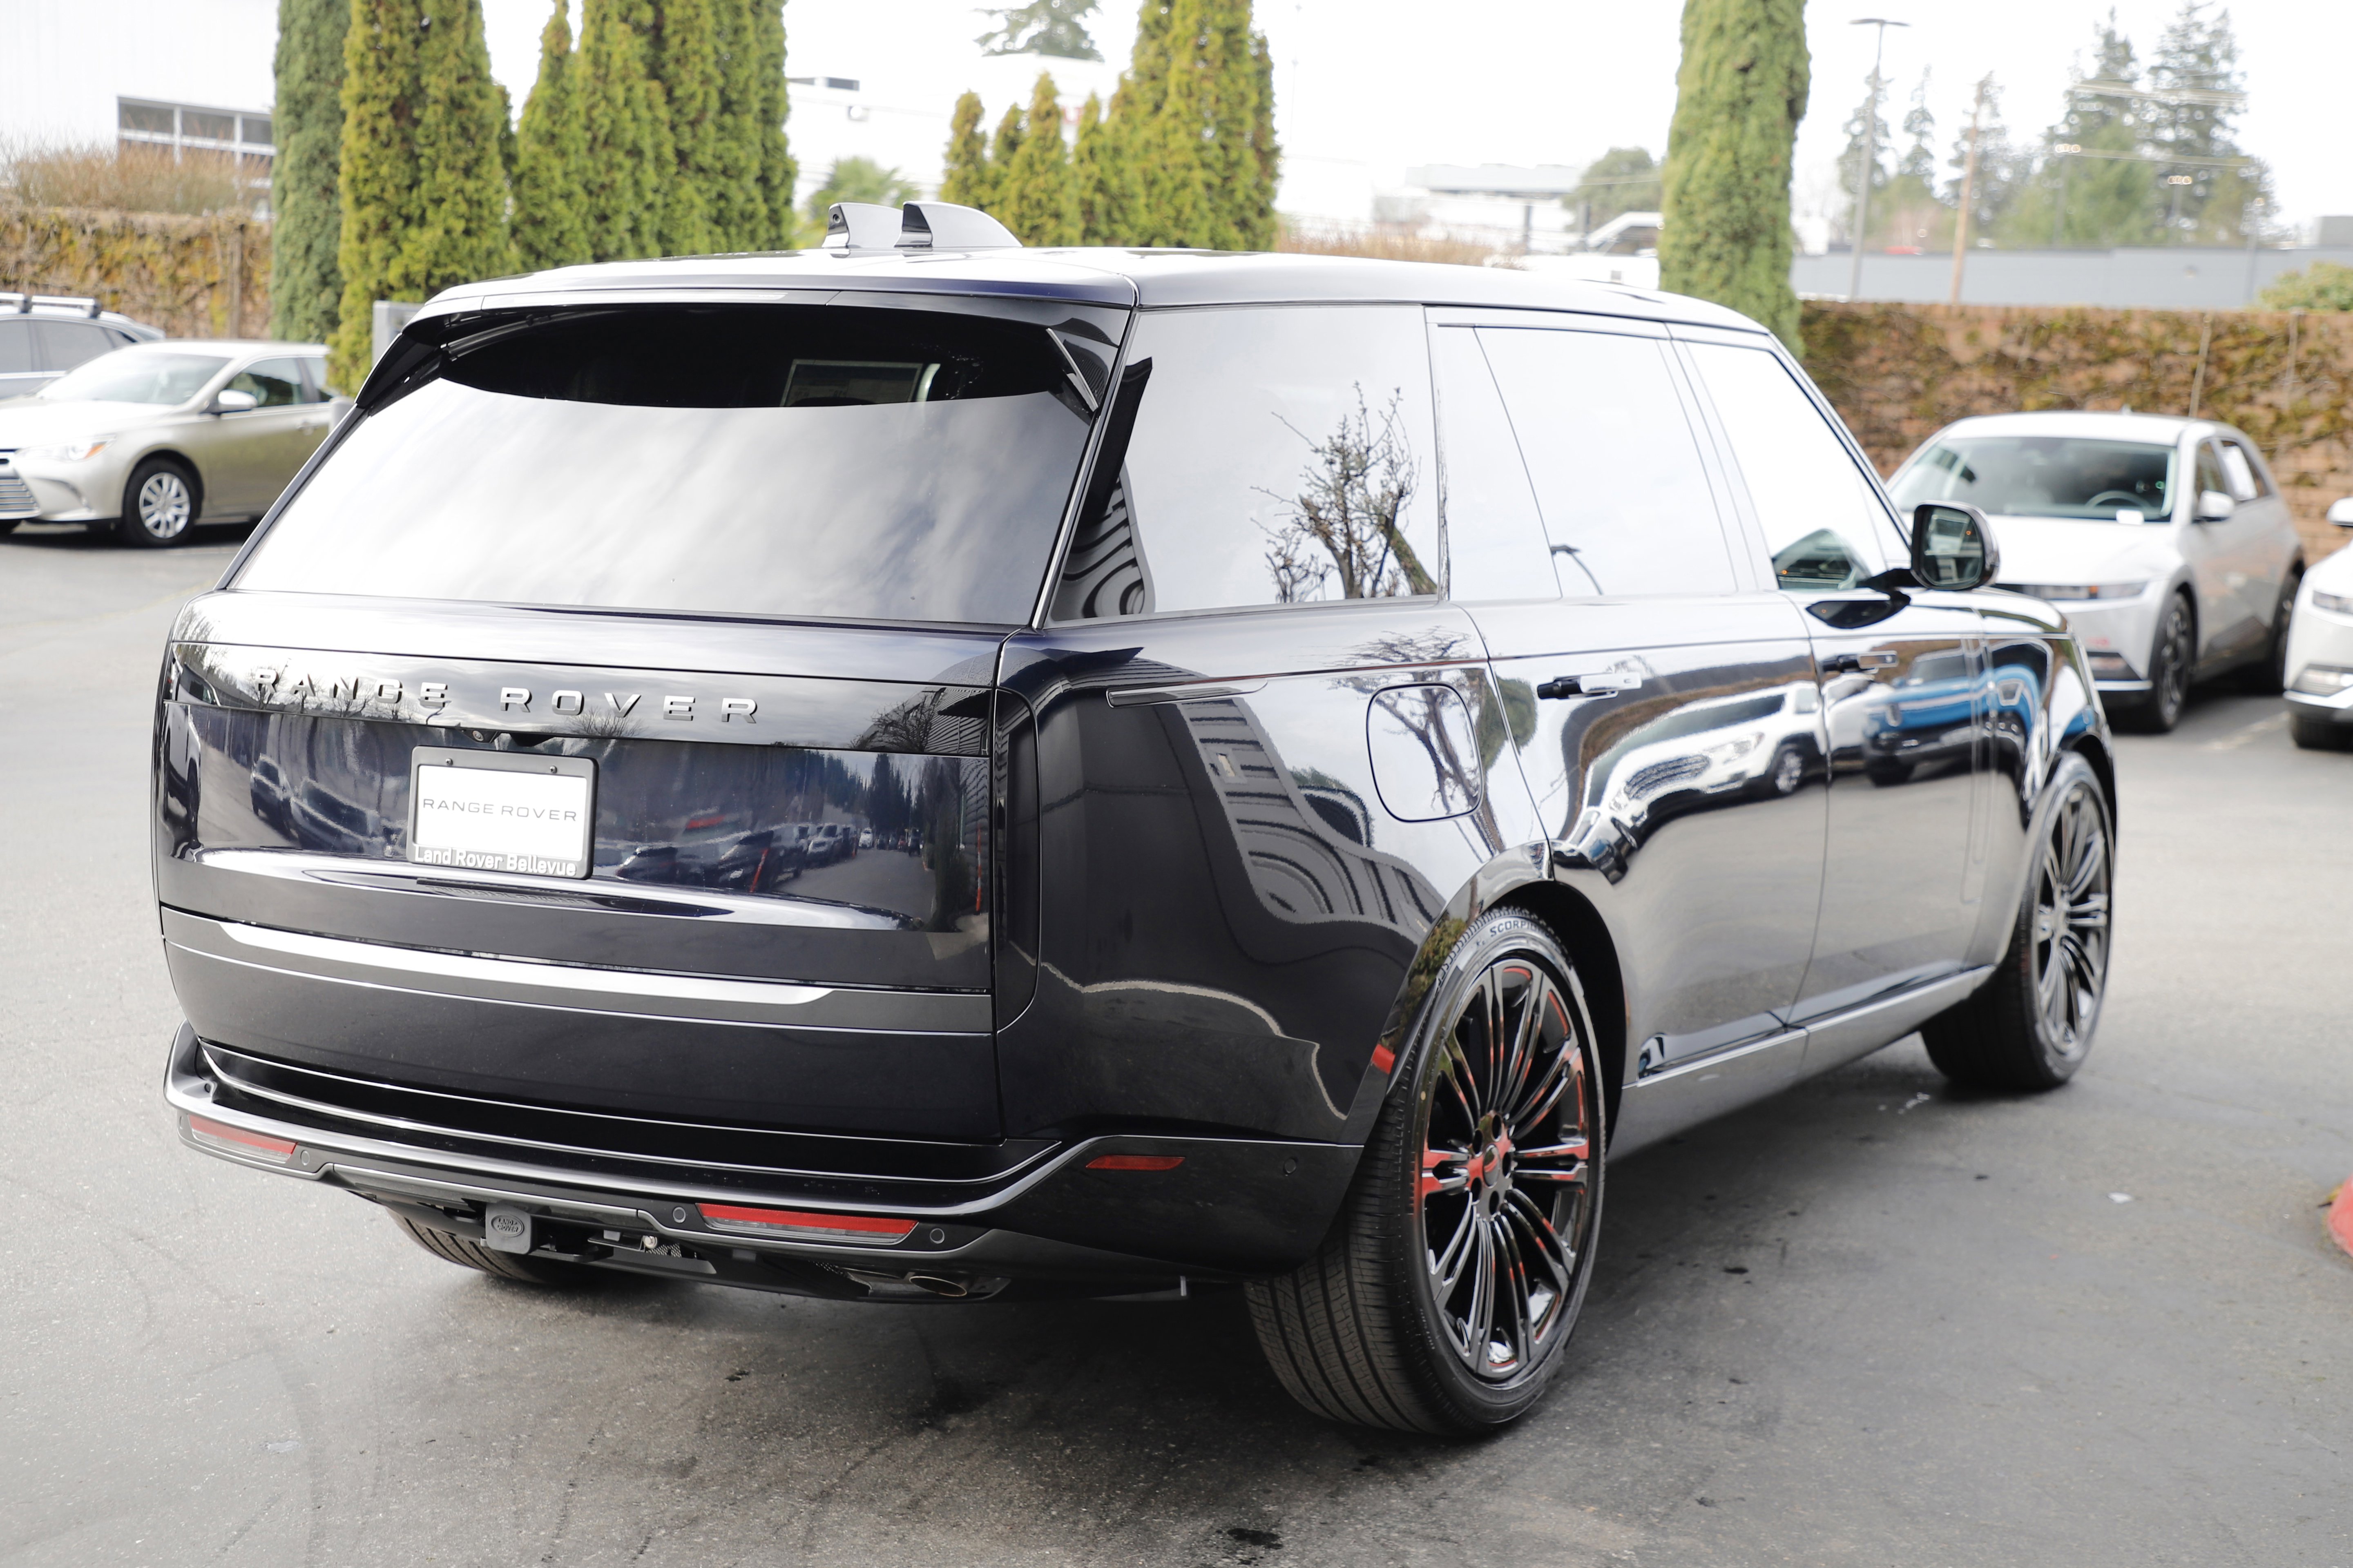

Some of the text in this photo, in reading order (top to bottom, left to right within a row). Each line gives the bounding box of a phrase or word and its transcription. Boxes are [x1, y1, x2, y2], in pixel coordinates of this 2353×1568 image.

[254, 668, 758, 724] RANGE ROVER
[423, 798, 577, 821] RANGE ROVER
[415, 845, 576, 876] Land Rover Bellevue
